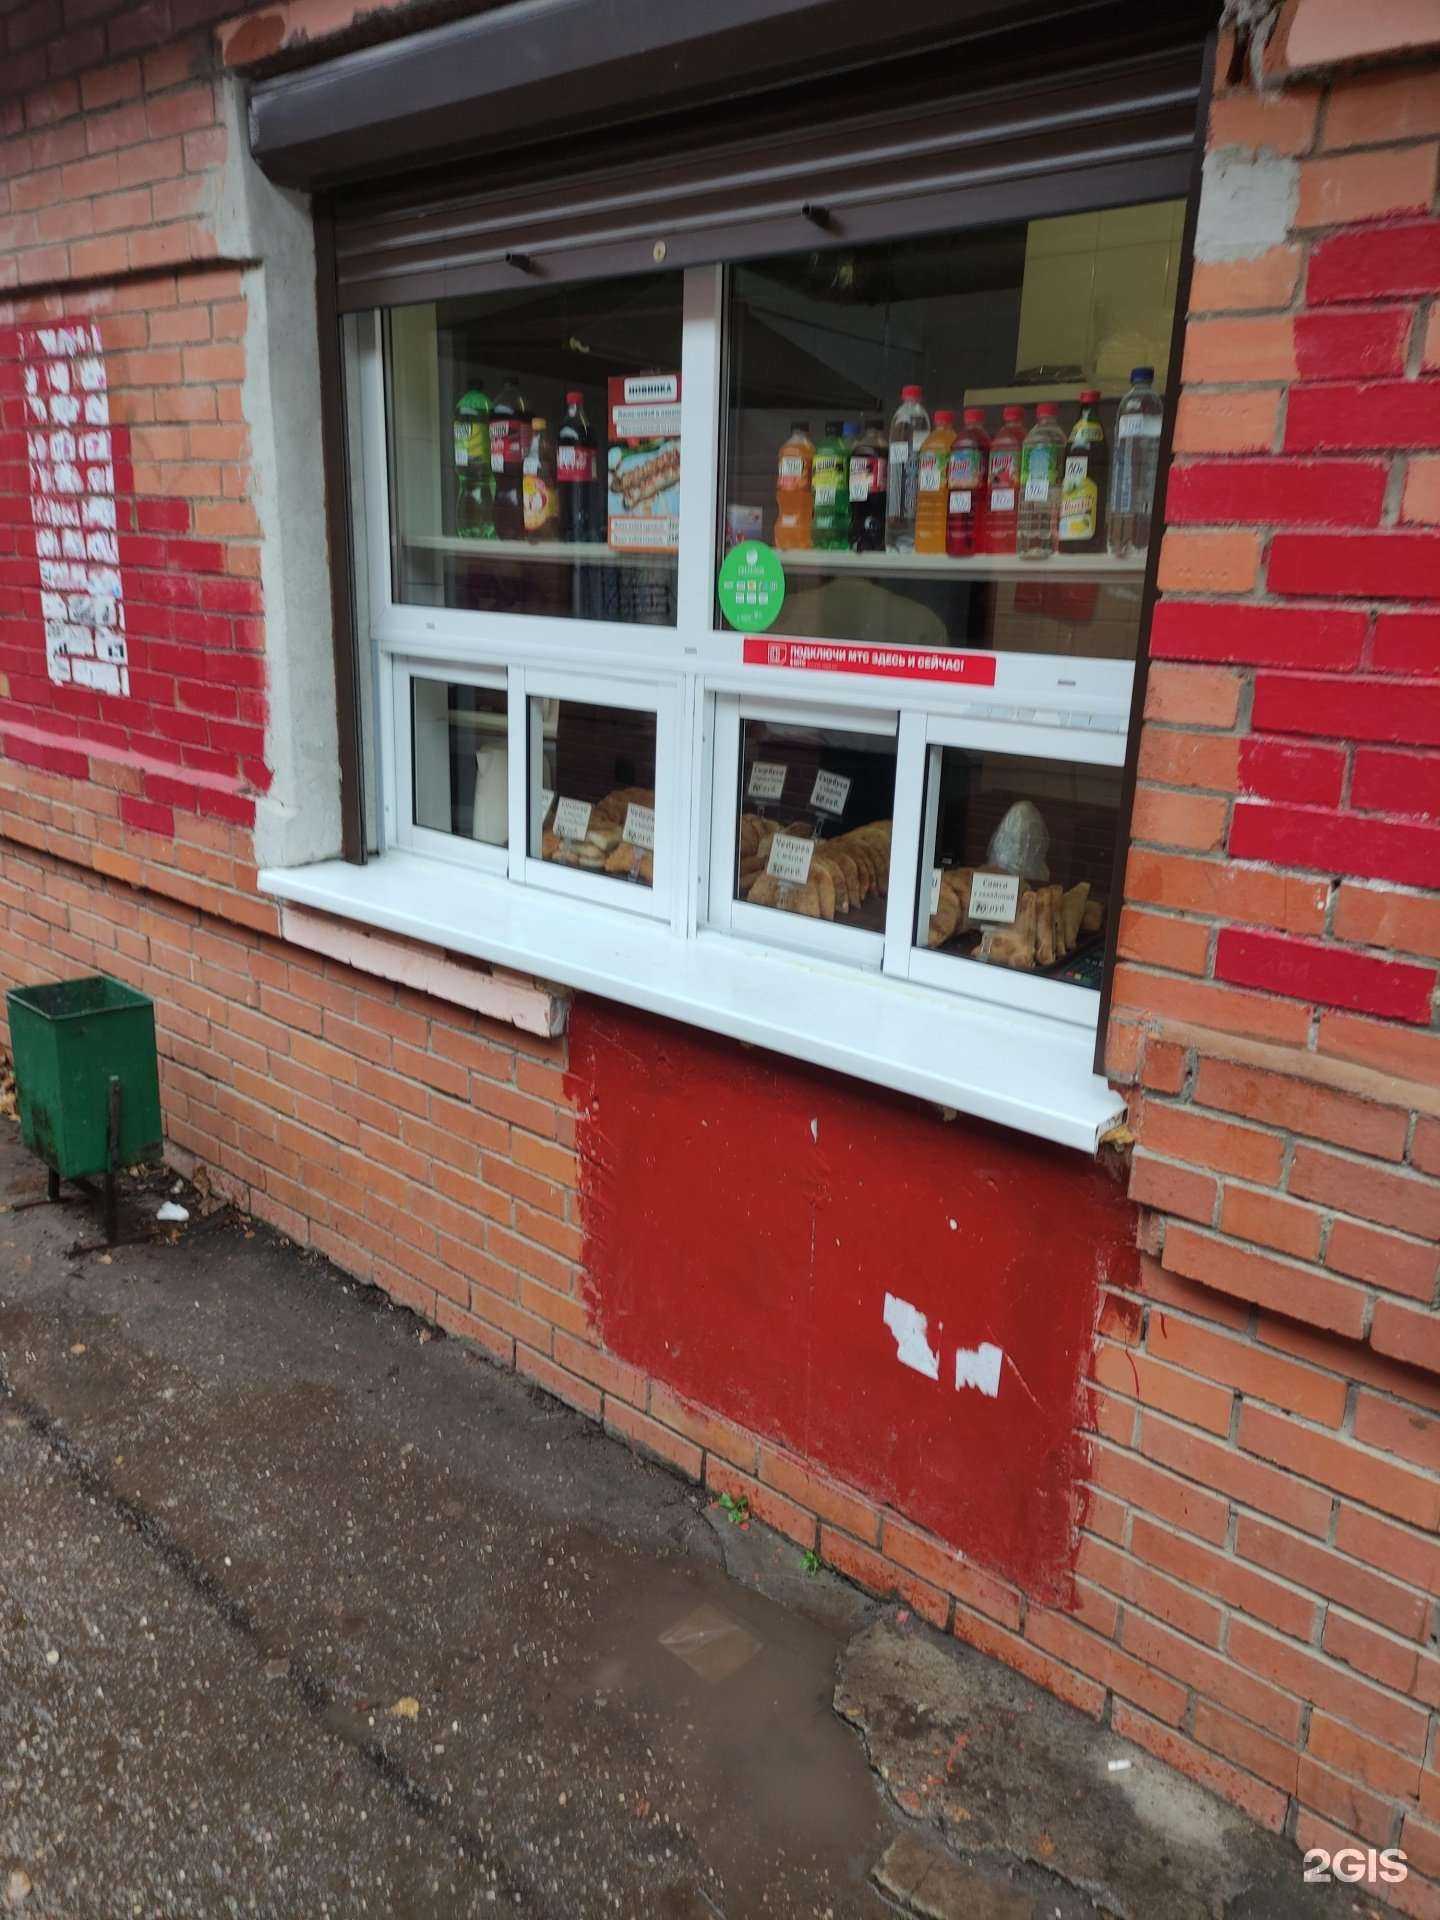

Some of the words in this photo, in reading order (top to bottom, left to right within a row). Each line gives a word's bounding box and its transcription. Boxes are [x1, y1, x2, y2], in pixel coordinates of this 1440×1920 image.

[790, 644, 847, 662] ПОДКЛЮЧИ
[848, 649, 869, 665] МТС
[872, 652, 905, 667] ЗДЕСЬ
[907, 654, 915, 669] И
[917, 654, 965, 672] СЕЙЧАС!
